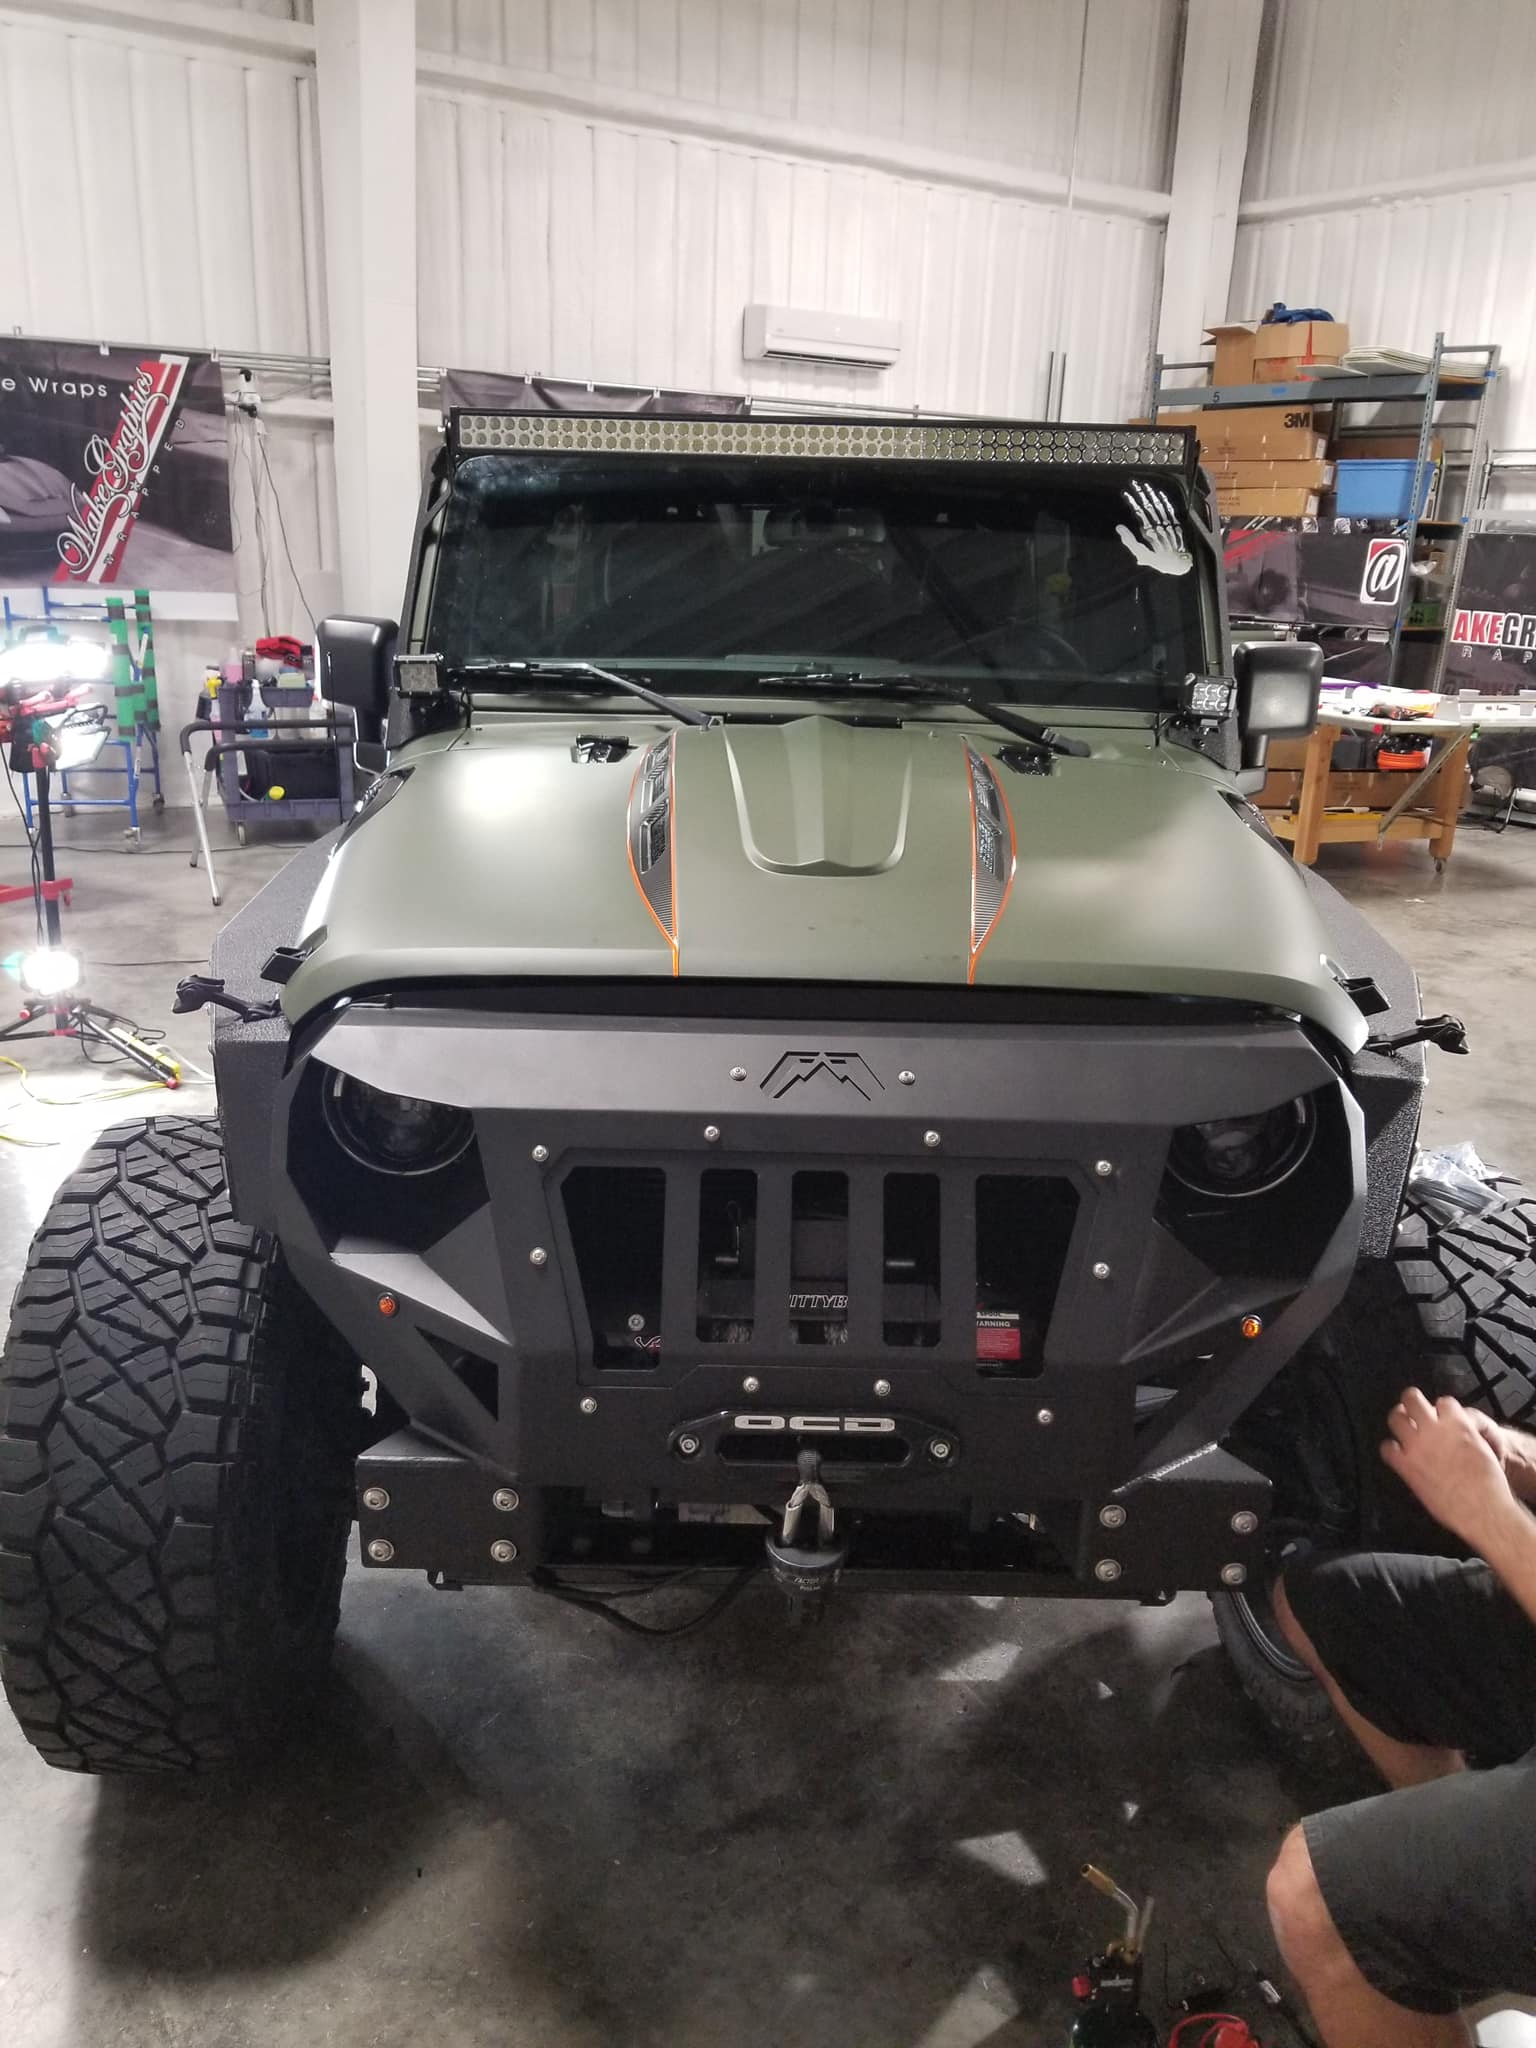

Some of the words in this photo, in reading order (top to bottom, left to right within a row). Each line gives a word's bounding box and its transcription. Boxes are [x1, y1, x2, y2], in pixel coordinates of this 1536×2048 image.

[28, 375, 108, 399] Wraps
[84, 366, 169, 492] Graphics
[1284, 412, 1311, 429] 3M
[1450, 609, 1536, 650] AKEGR
[789, 1294, 848, 1309] ITTYB
[976, 1320, 1011, 1328] ARNING
